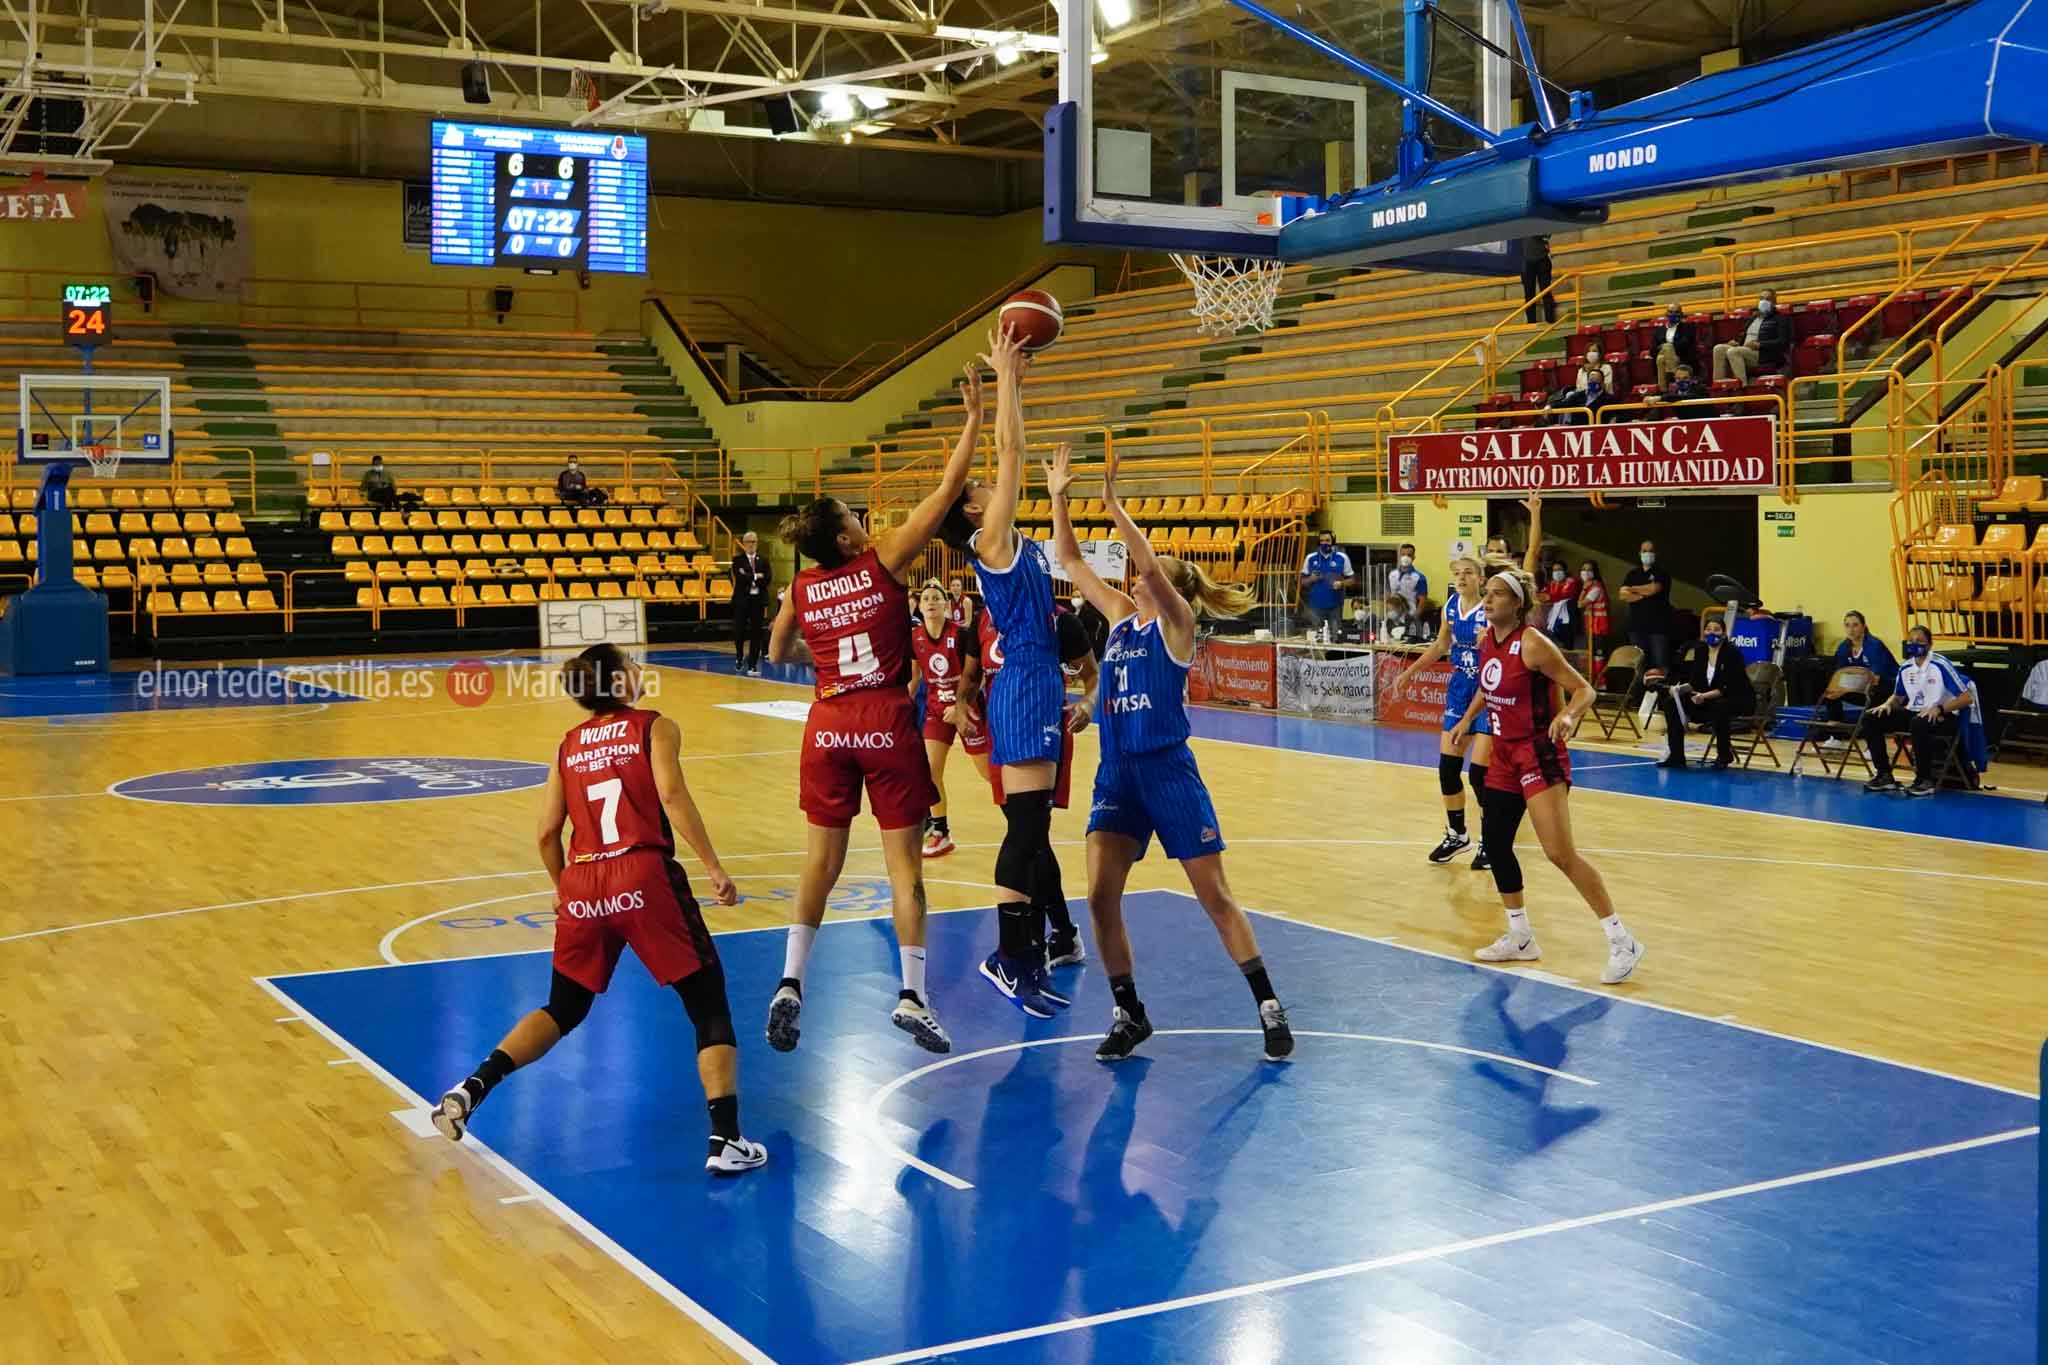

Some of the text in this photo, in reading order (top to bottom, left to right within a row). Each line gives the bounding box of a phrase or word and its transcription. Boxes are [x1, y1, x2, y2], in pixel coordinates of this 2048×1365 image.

[508, 153, 575, 180] 6 6
[1589, 144, 1657, 173] MONDO
[0, 192, 76, 219] ETA
[1372, 201, 1428, 229] MONDO
[508, 208, 574, 235] 07:22
[511, 235, 525, 254] 0
[558, 238, 572, 257] 0
[65, 285, 111, 301] 07:22
[68, 309, 105, 335] 24
[1459, 423, 1724, 463] SALAMANCA
[1424, 456, 1765, 489] PATRIMONIO DE LA HUMANIDAD
[805, 569, 873, 604] NICHOLLS
[803, 592, 885, 624] MARATHON
[831, 612, 861, 630] BET
[837, 631, 881, 677] 4
[580, 720, 629, 745] WURTZ
[815, 731, 895, 749] SOMMOS
[566, 743, 640, 768] MARATHON
[589, 755, 614, 773] BET
[586, 777, 623, 845] 7
